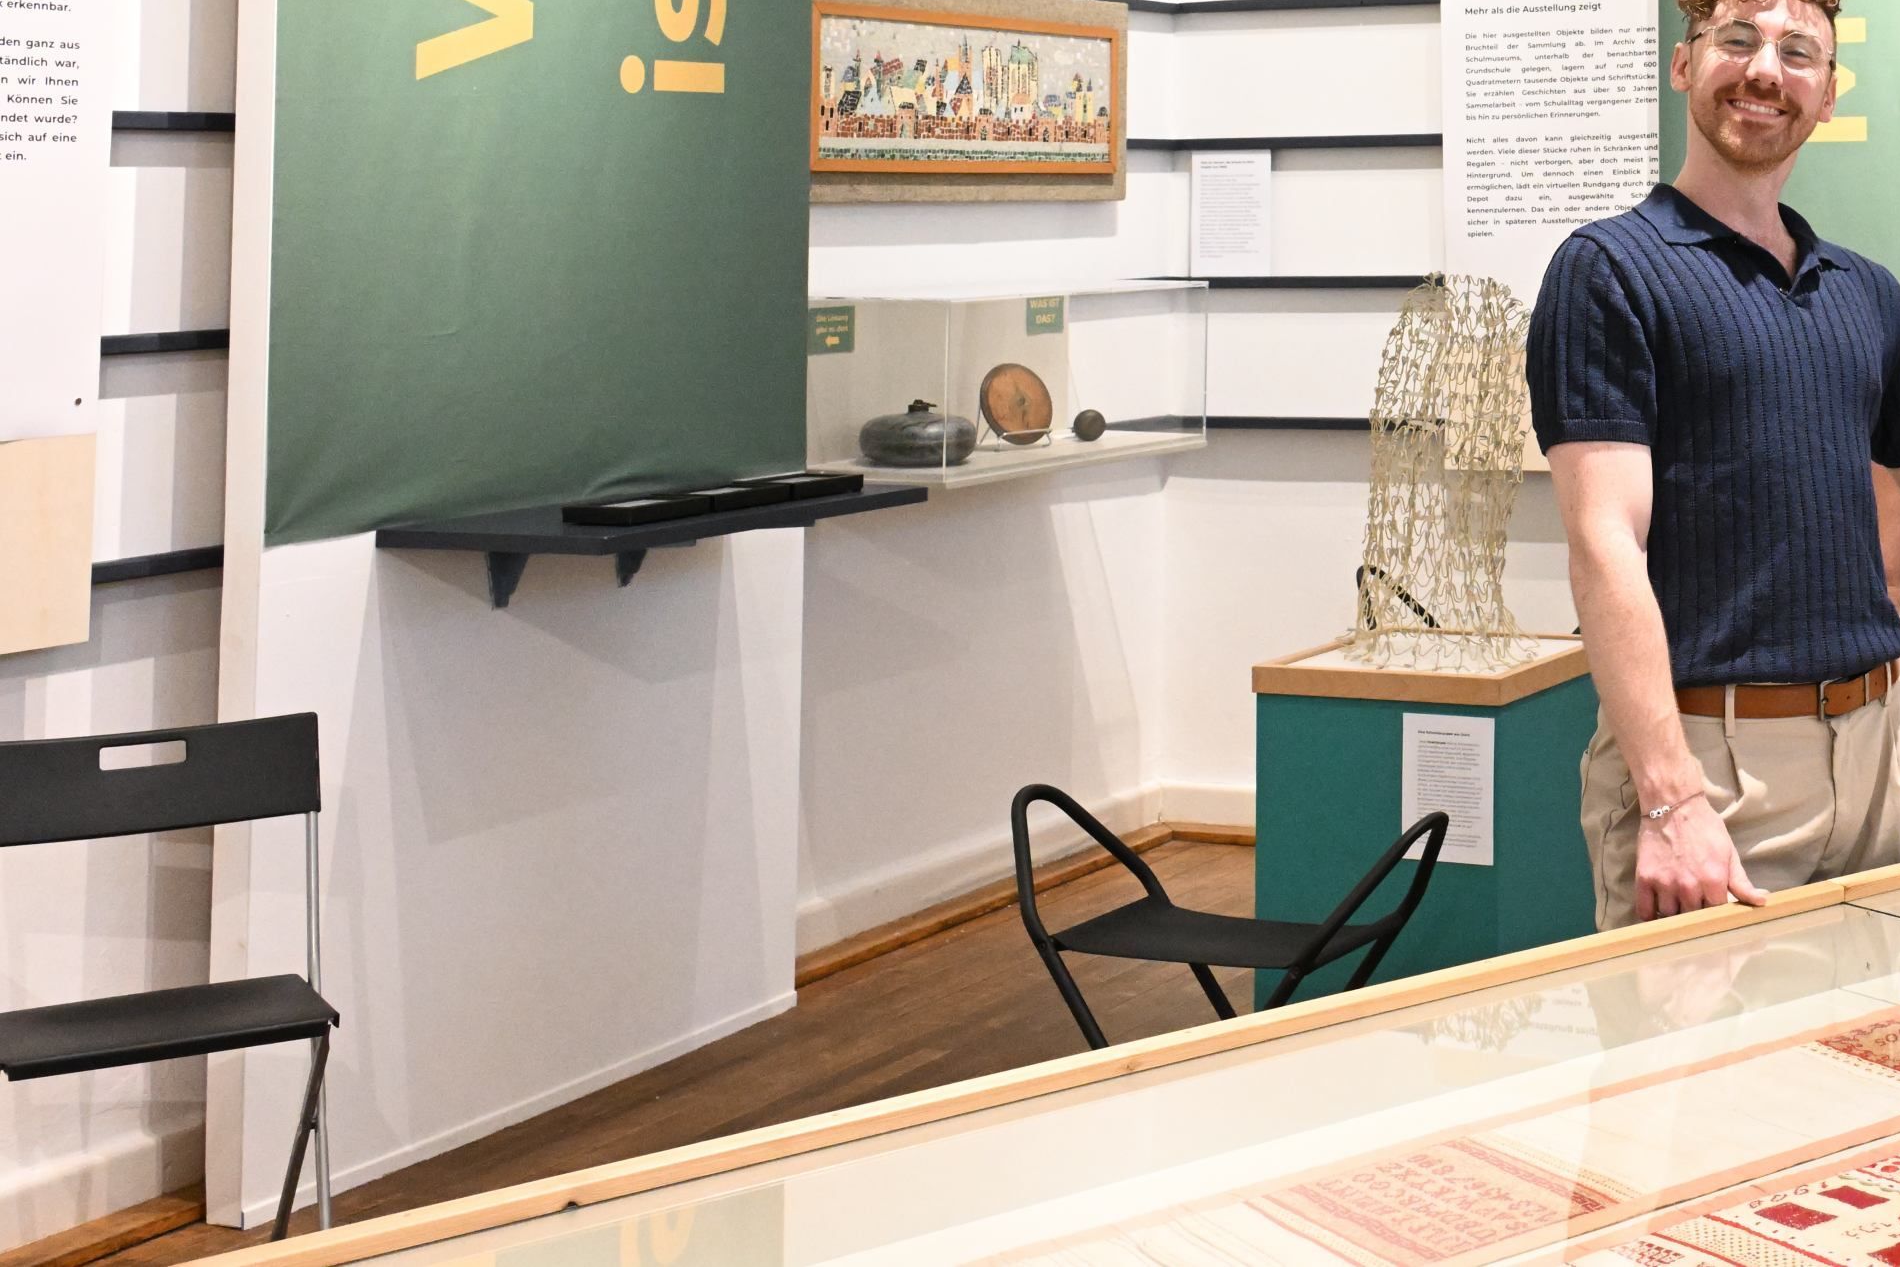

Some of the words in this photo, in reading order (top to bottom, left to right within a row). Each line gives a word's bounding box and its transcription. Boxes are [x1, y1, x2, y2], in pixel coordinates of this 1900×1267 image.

[6, 0, 72, 12] erkennbar.
[1464, 6, 1489, 15] Mehr
[1490, 6, 1505, 15] als
[1505, 5, 1521, 14] die
[1522, 3, 1577, 14] Ausstellung
[1578, 1, 1602, 12] zeigt
[25, 39, 55, 50] ganz
[59, 41, 81, 50] aus
[1527, 41, 1567, 50] Sammlung
[1612, 37, 1636, 46] Archiv
[1606, 49, 1657, 58] benachbarten
[54, 60, 80, 70] war,
[1561, 63, 1585, 73] lagern
[17, 76, 37, 86] wir
[44, 76, 79, 87] Ihnen
[1523, 76, 1558, 85] tausende
[1559, 75, 1589, 84] Objekte
[1521, 87, 1567, 96] Geschichten
[6, 93, 53, 105] Können
[60, 94, 79, 106] Sie
[1586, 98, 1633, 107] vergangener
[33, 114, 78, 124] wurde?
[27, 132, 48, 142] auf
[51, 134, 78, 143] eine
[1465, 136, 1486, 145] Nicht
[1569, 133, 1612, 143] gleichzeitig
[5, 150, 27, 161] ein.
[1517, 146, 1541, 155] dieser
[1466, 160, 1496, 169] Regalen
[1542, 169, 1575, 178] dennoch
[1612, 167, 1641, 176] Einblick
[1545, 181, 1581, 190] virtuellen
[1622, 179, 1644, 188] durch
[1466, 195, 1489, 204] Depot
[1493, 217, 1501, 226] in
